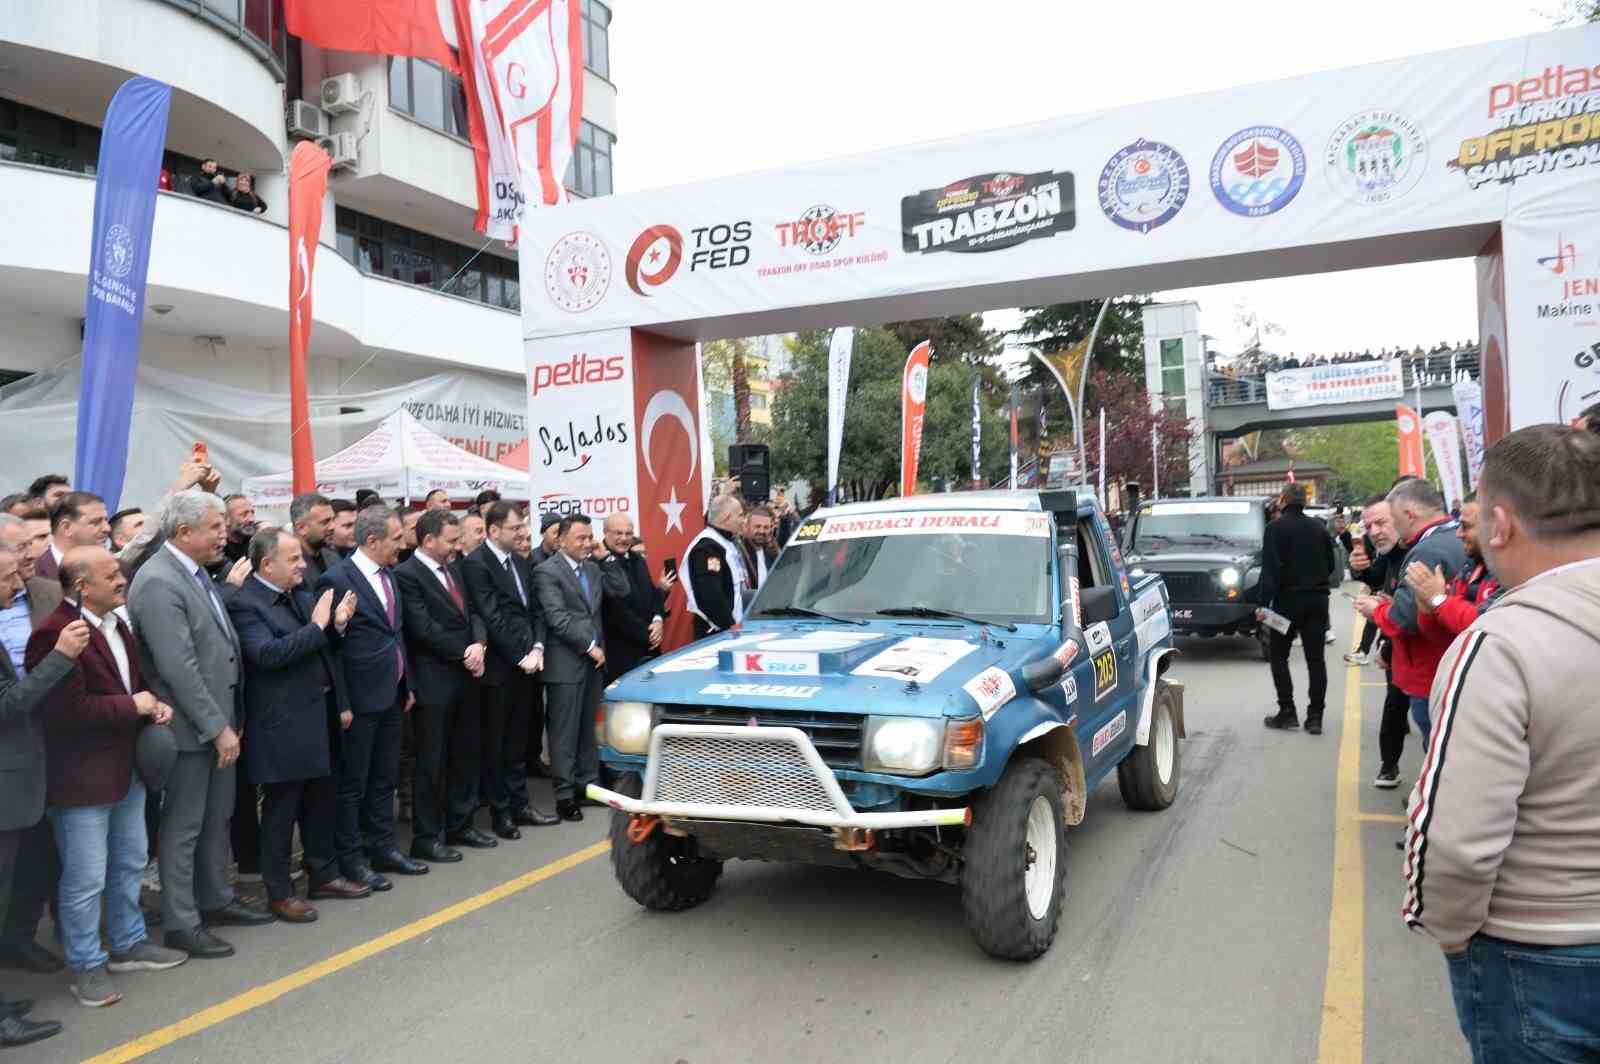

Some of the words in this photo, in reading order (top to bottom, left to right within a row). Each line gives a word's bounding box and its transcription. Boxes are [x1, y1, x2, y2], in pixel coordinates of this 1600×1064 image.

[911, 185, 1061, 250] TRABZON
[691, 221, 752, 249] TOS
[690, 245, 751, 273] FED
[1537, 304, 1591, 319] Makine
[532, 353, 625, 396] petlas
[425, 404, 459, 425] DAHA
[463, 402, 480, 425] İYİ
[538, 414, 628, 466] Salados
[1097, 653, 1114, 689] 203
